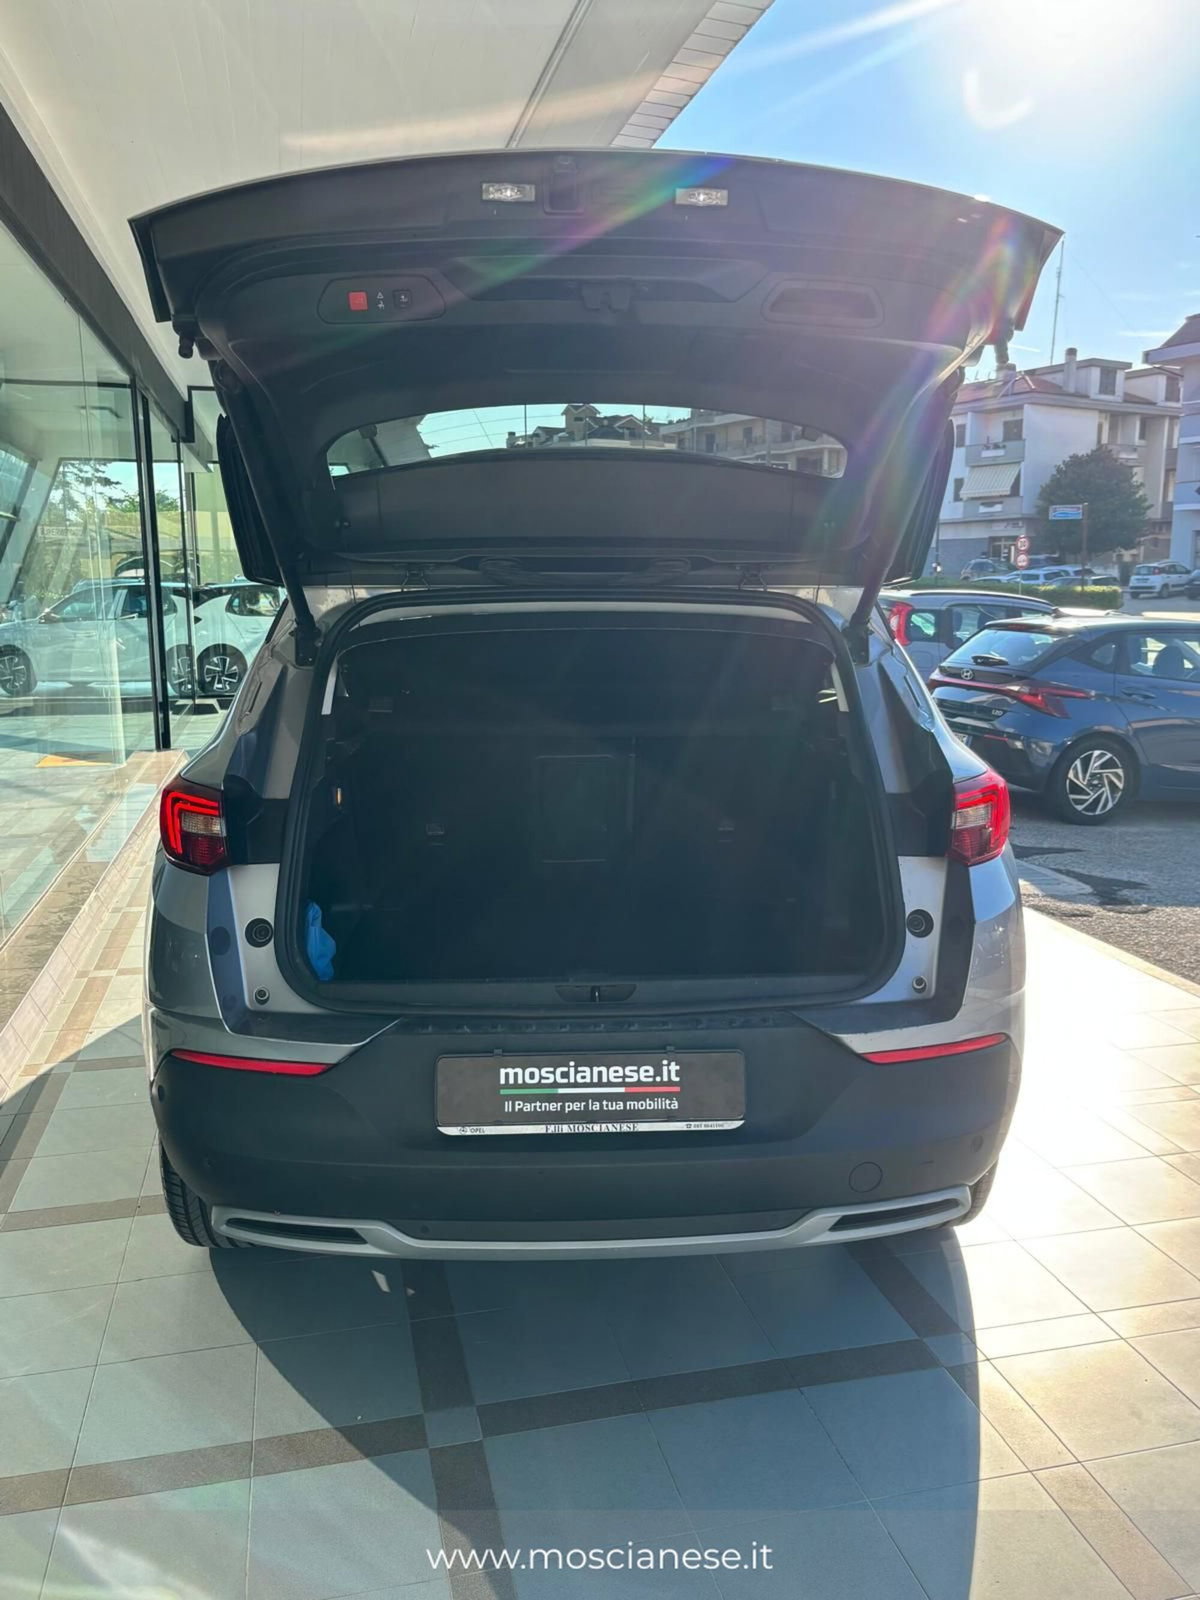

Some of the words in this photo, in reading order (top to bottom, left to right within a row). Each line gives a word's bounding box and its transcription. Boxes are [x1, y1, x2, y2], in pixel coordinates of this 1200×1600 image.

[499, 1060, 680, 1086] moscianese.it
[504, 1101, 512, 1112] Il
[515, 1100, 563, 1112] Partner
[565, 1101, 586, 1113] per
[588, 1099, 600, 1111] la
[602, 1099, 624, 1111] tua
[626, 1097, 679, 1110] mobilità
[567, 1123, 639, 1132] MOSCIANESE
